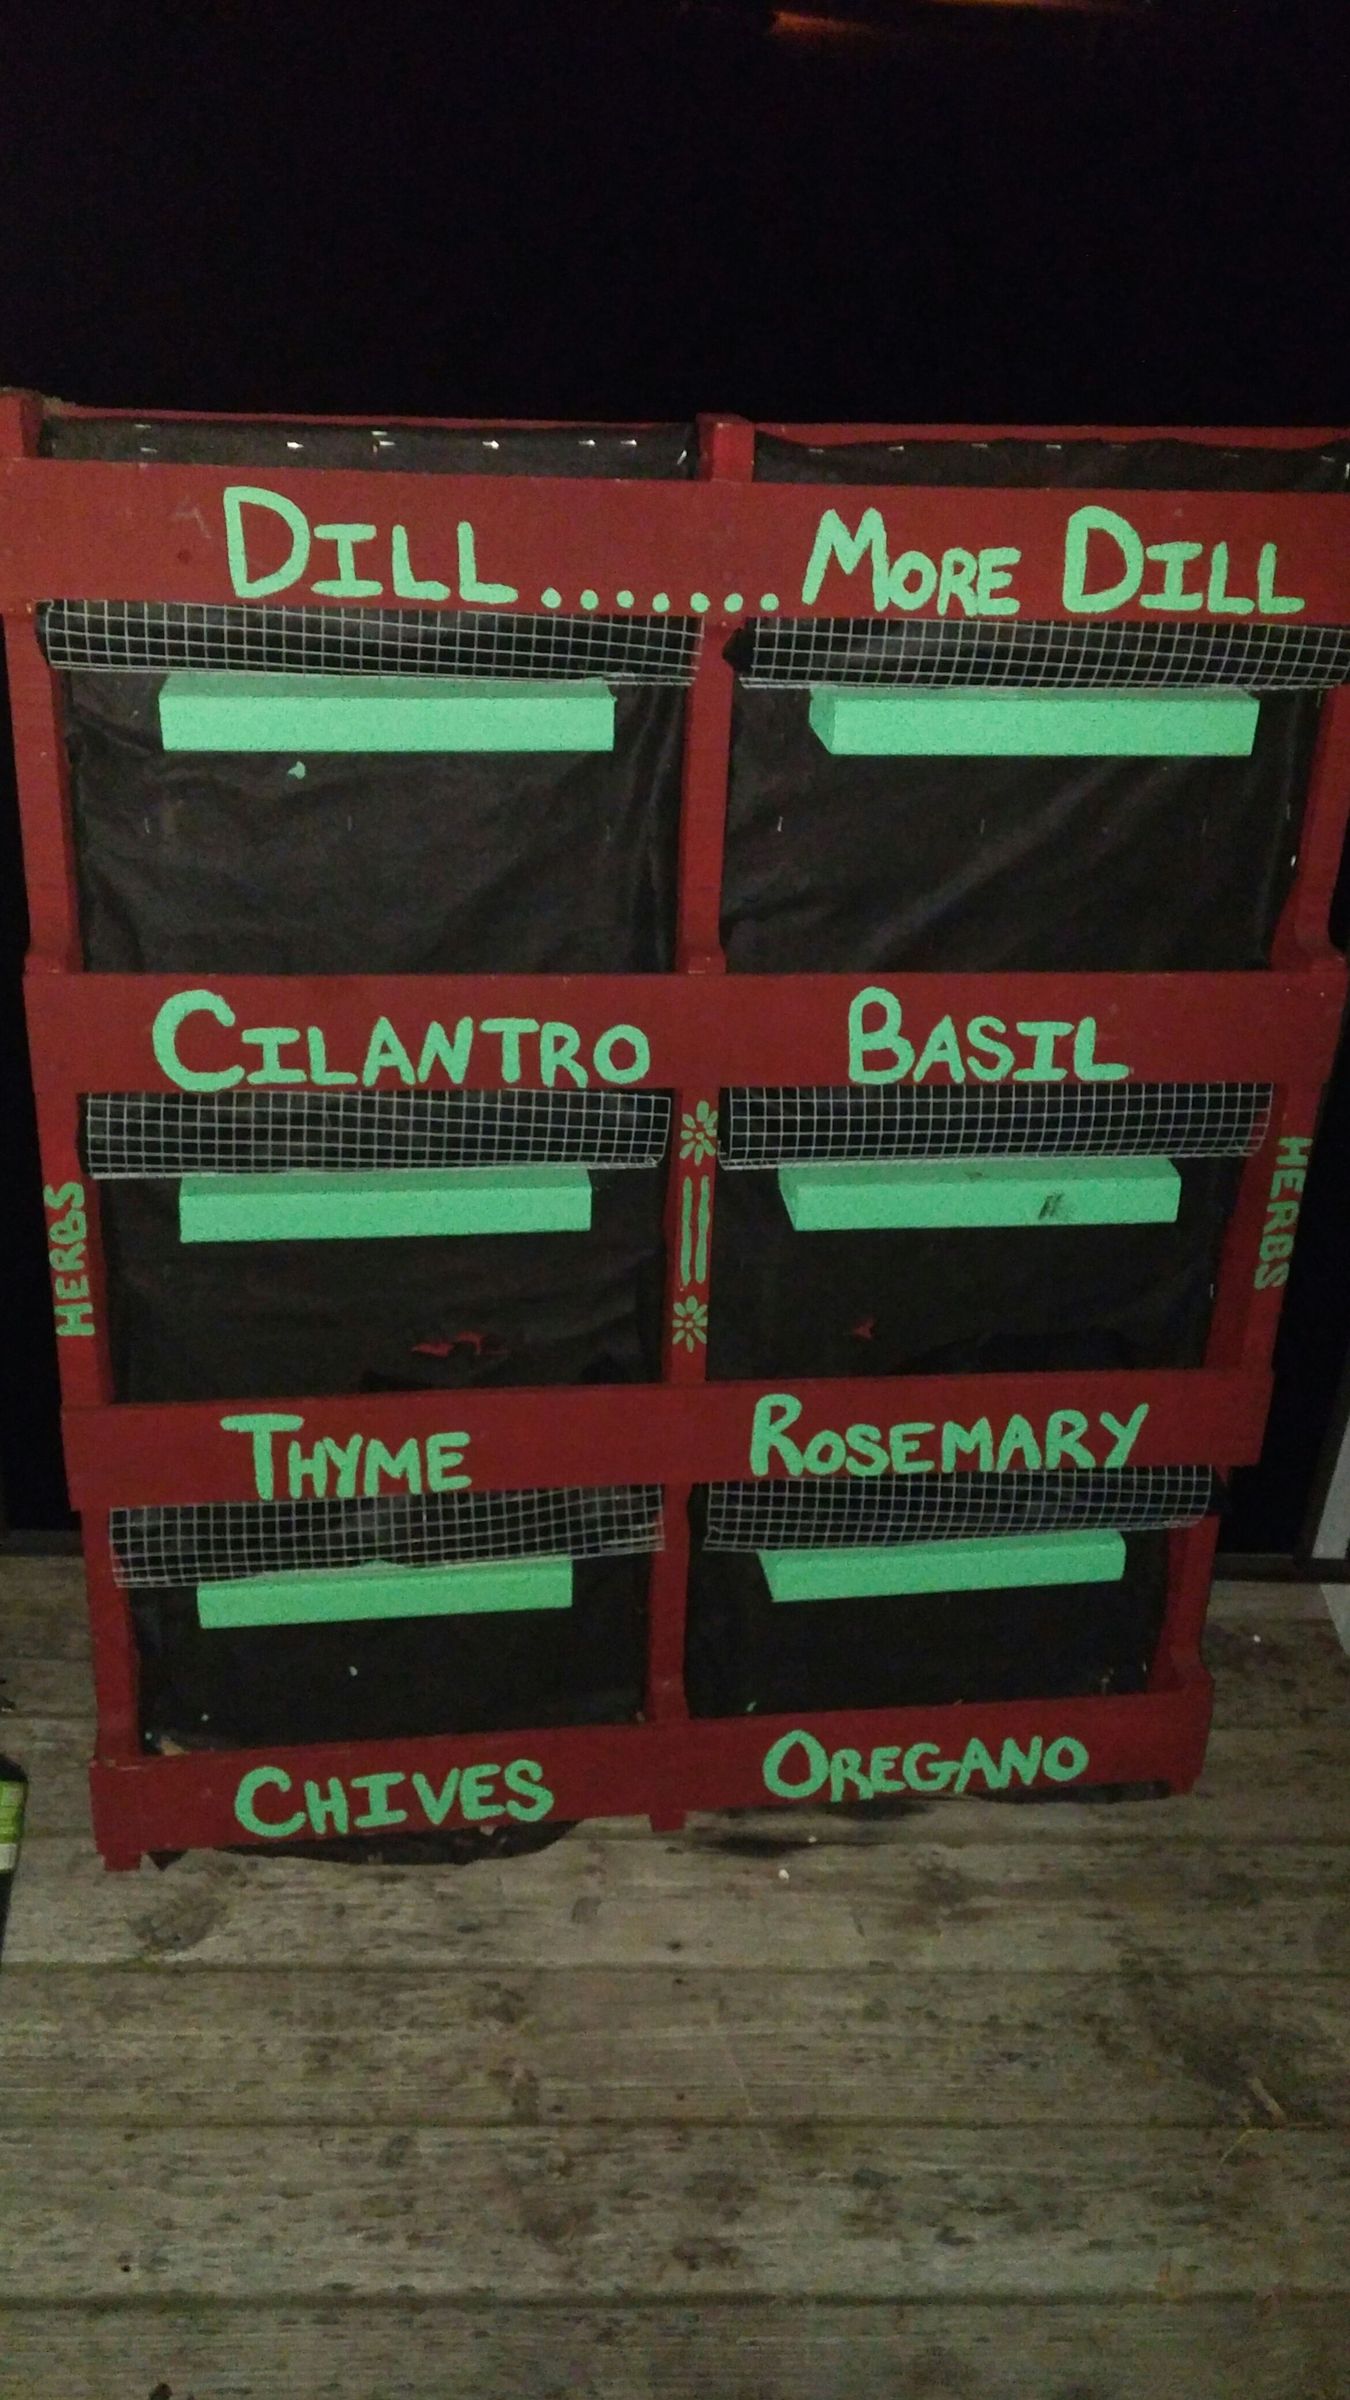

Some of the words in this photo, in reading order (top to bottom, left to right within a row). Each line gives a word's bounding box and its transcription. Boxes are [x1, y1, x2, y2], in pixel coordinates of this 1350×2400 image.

[802, 507, 1021, 617] MORE
[1063, 506, 1305, 614] DILL
[152, 987, 650, 1094] CILANTRO
[848, 986, 1131, 1088] BASIL
[42, 1181, 96, 1336] HERBS
[1253, 1136, 1314, 1291] HERBS
[220, 1413, 472, 1503] THYME
[750, 1393, 1149, 1481] ROSEMARY
[234, 1759, 555, 1838] CHIVES
[762, 1730, 1090, 1803] OREGANO
